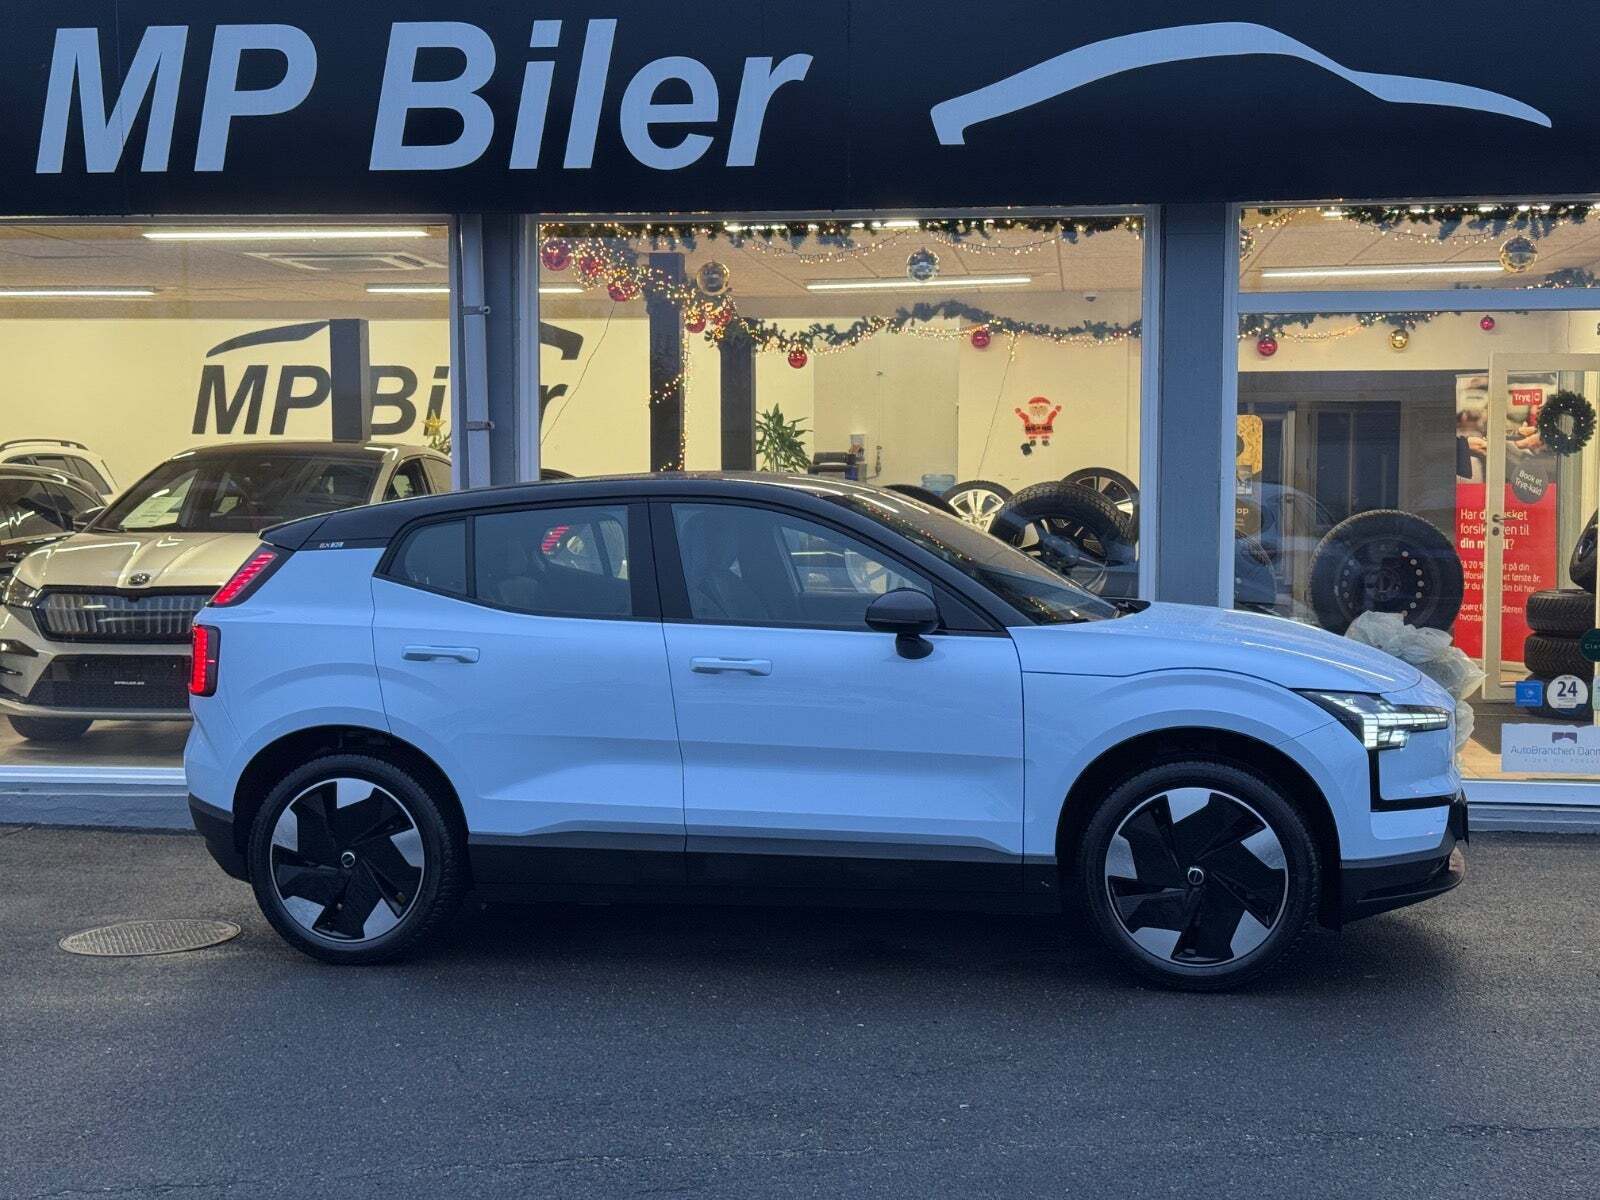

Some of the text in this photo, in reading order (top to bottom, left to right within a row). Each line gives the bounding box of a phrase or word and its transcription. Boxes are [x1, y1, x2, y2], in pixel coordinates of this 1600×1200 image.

[35, 18, 814, 174] MP Biler
[191, 365, 331, 435] MP
[1514, 393, 1531, 403] Tryg
[1519, 470, 1536, 484] Book
[1460, 509, 1477, 520] Har
[1519, 524, 1530, 536] til
[1460, 538, 1475, 549] din
[1557, 680, 1578, 698] 24
[1510, 745, 1575, 756] AutoBranchen
